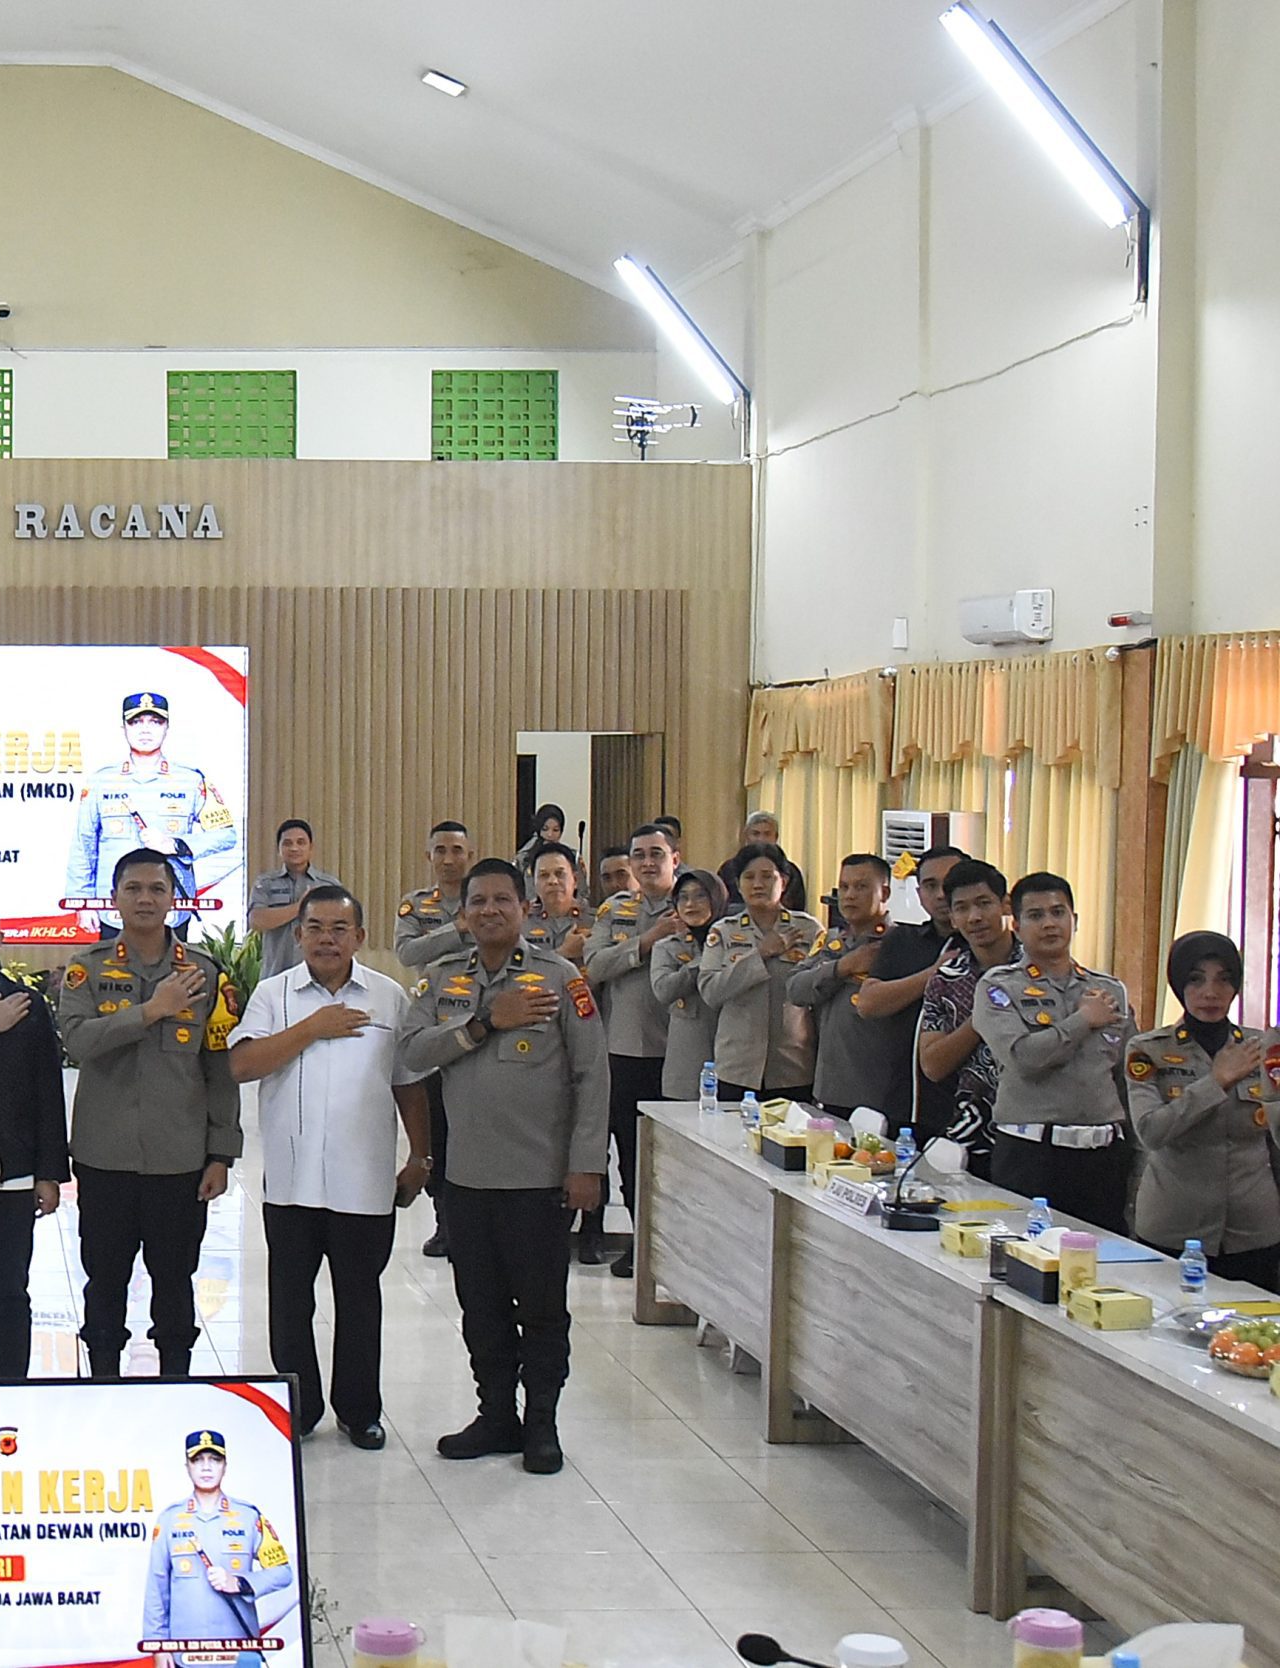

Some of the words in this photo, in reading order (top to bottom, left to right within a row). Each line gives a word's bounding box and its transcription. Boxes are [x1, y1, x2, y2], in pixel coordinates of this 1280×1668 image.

[14, 503, 224, 539] RACANA
[20, 782, 75, 802] (MKD)
[1, 929, 29, 939] ERJA
[30, 926, 78, 938] IKHLAS
[98, 981, 134, 993] NIKO
[39, 1469, 154, 1514] KERJA
[36, 1523, 94, 1539] DEWAN
[98, 1522, 147, 1542] (MKD)
[15, 1592, 54, 1606] JAWA
[57, 1591, 102, 1605] BARAT
